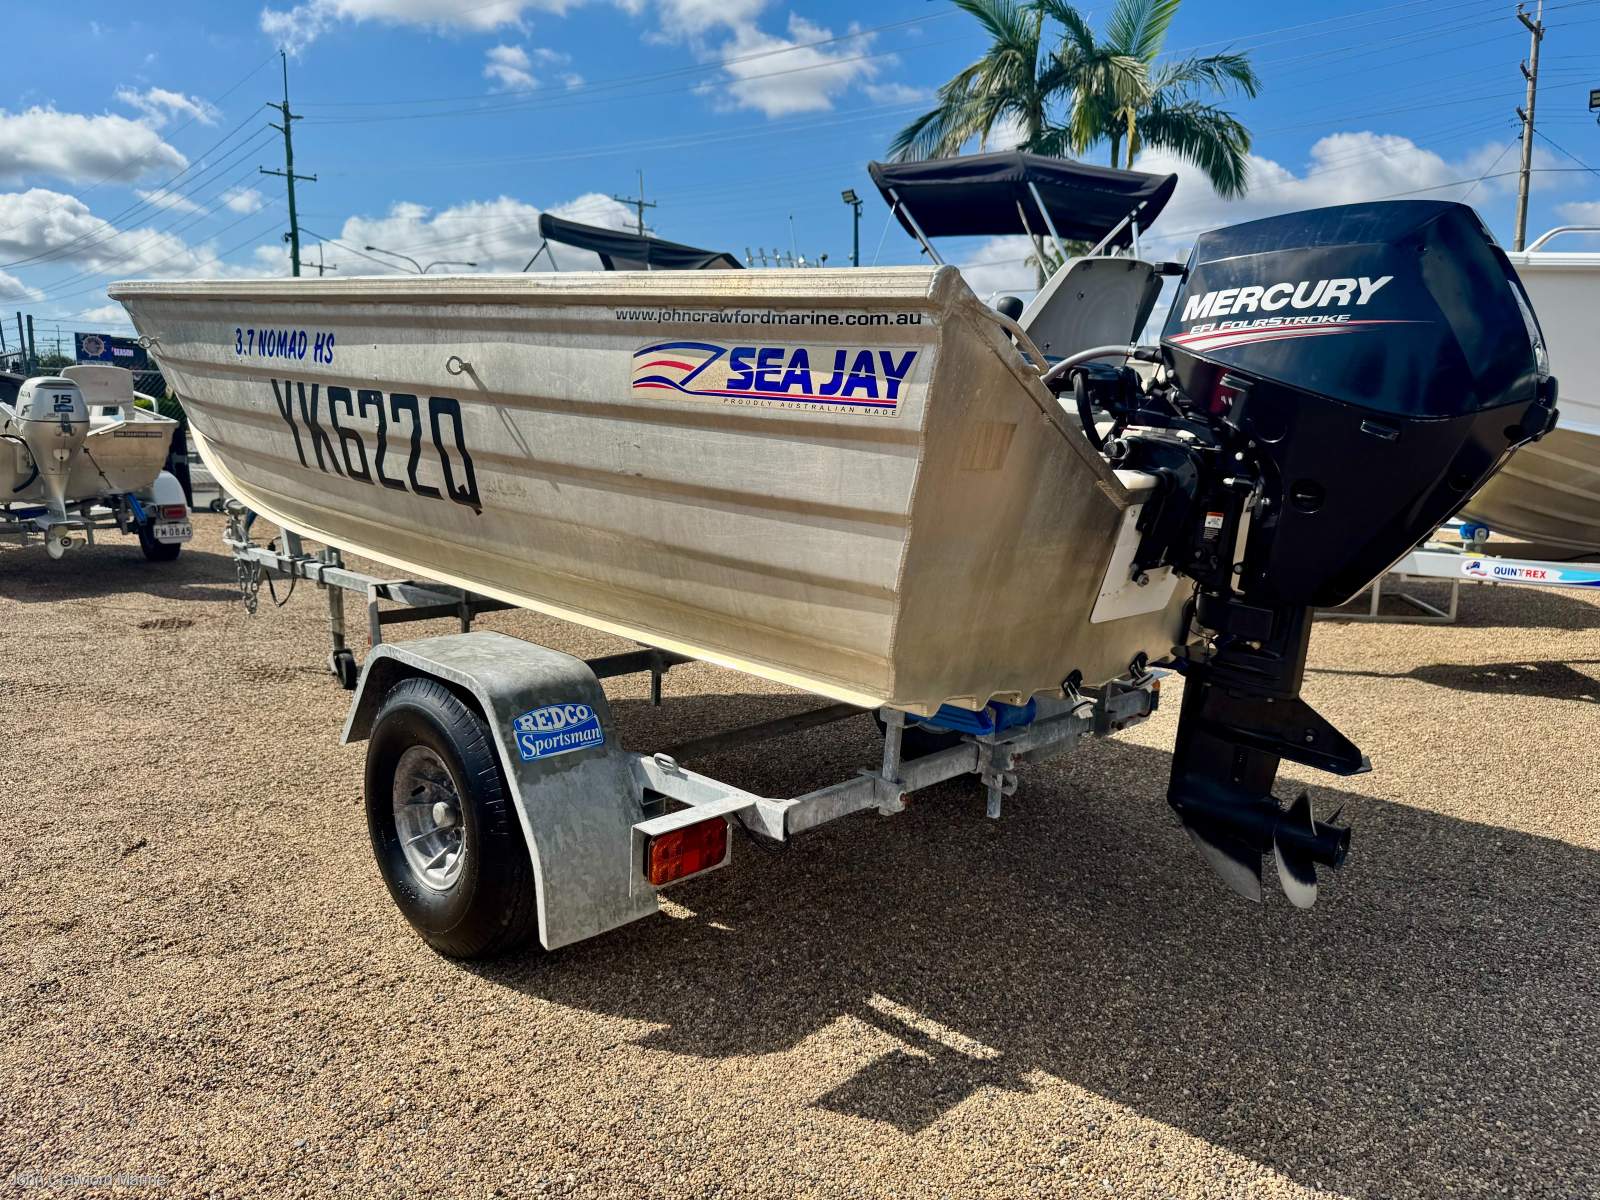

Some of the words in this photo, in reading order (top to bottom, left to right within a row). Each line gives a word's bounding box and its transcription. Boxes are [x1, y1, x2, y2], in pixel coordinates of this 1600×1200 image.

[1180, 276, 1394, 322] MERCURY
[616, 309, 922, 326] www.johncrawfordmarine.com.au
[1189, 323, 1217, 335] EFI
[1218, 314, 1351, 331] FOURSTROKE
[235, 328, 255, 357] 3.7
[258, 329, 308, 361] NOMAD
[314, 332, 335, 364] HS
[726, 347, 813, 395] SEA
[819, 350, 918, 399] JAY
[52, 394, 72, 404] 15
[723, 398, 772, 407] PROUDLY
[780, 402, 855, 413] AUSTRALIAN
[271, 379, 482, 516] YK622Q
[1494, 566, 1547, 579] QUINTREX
[520, 705, 589, 731] REDCO
[521, 727, 600, 757] Sportsman
